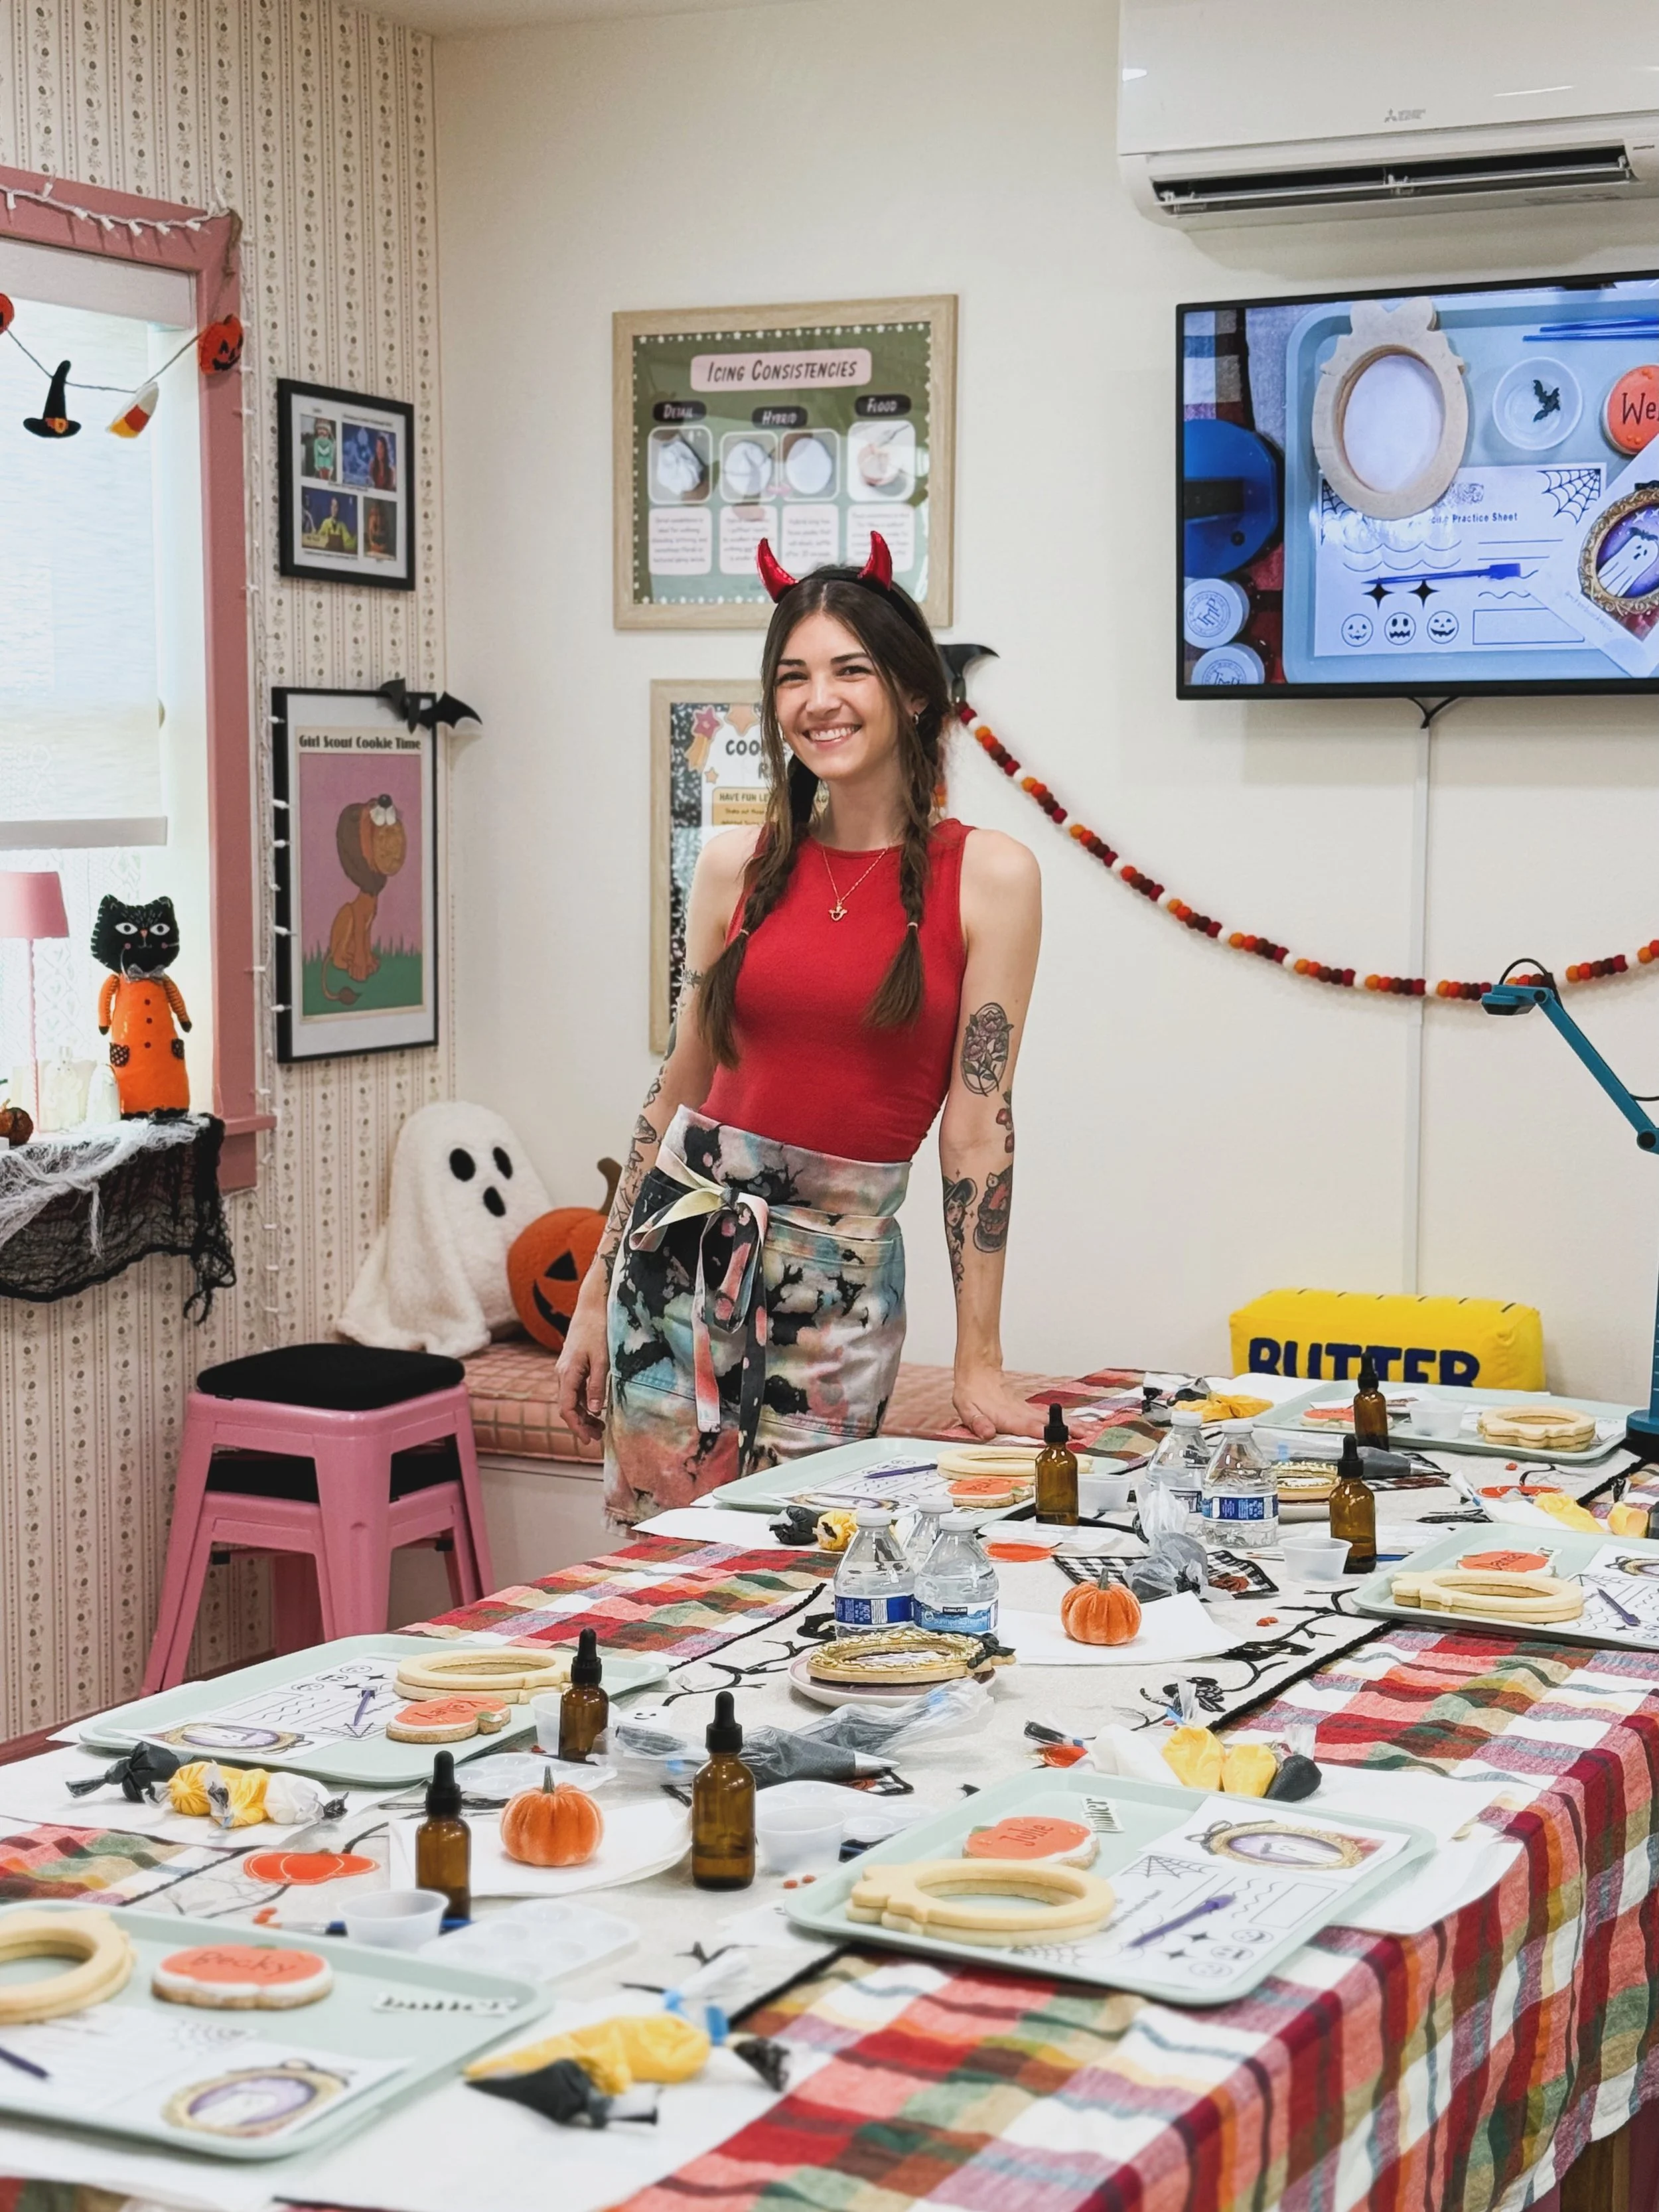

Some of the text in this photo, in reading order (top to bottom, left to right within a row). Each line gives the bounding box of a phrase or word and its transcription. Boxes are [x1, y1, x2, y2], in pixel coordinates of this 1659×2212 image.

[1452, 513, 1489, 523] Practice
[1492, 512, 1518, 522] Sheet
[299, 735, 421, 750] Girl Scout Cookie Time
[719, 792, 739, 802] HAVE
[742, 793, 757, 802] FUN
[1248, 1337, 1480, 1388] BUTTER
[999, 1824, 1054, 1848] Julie
